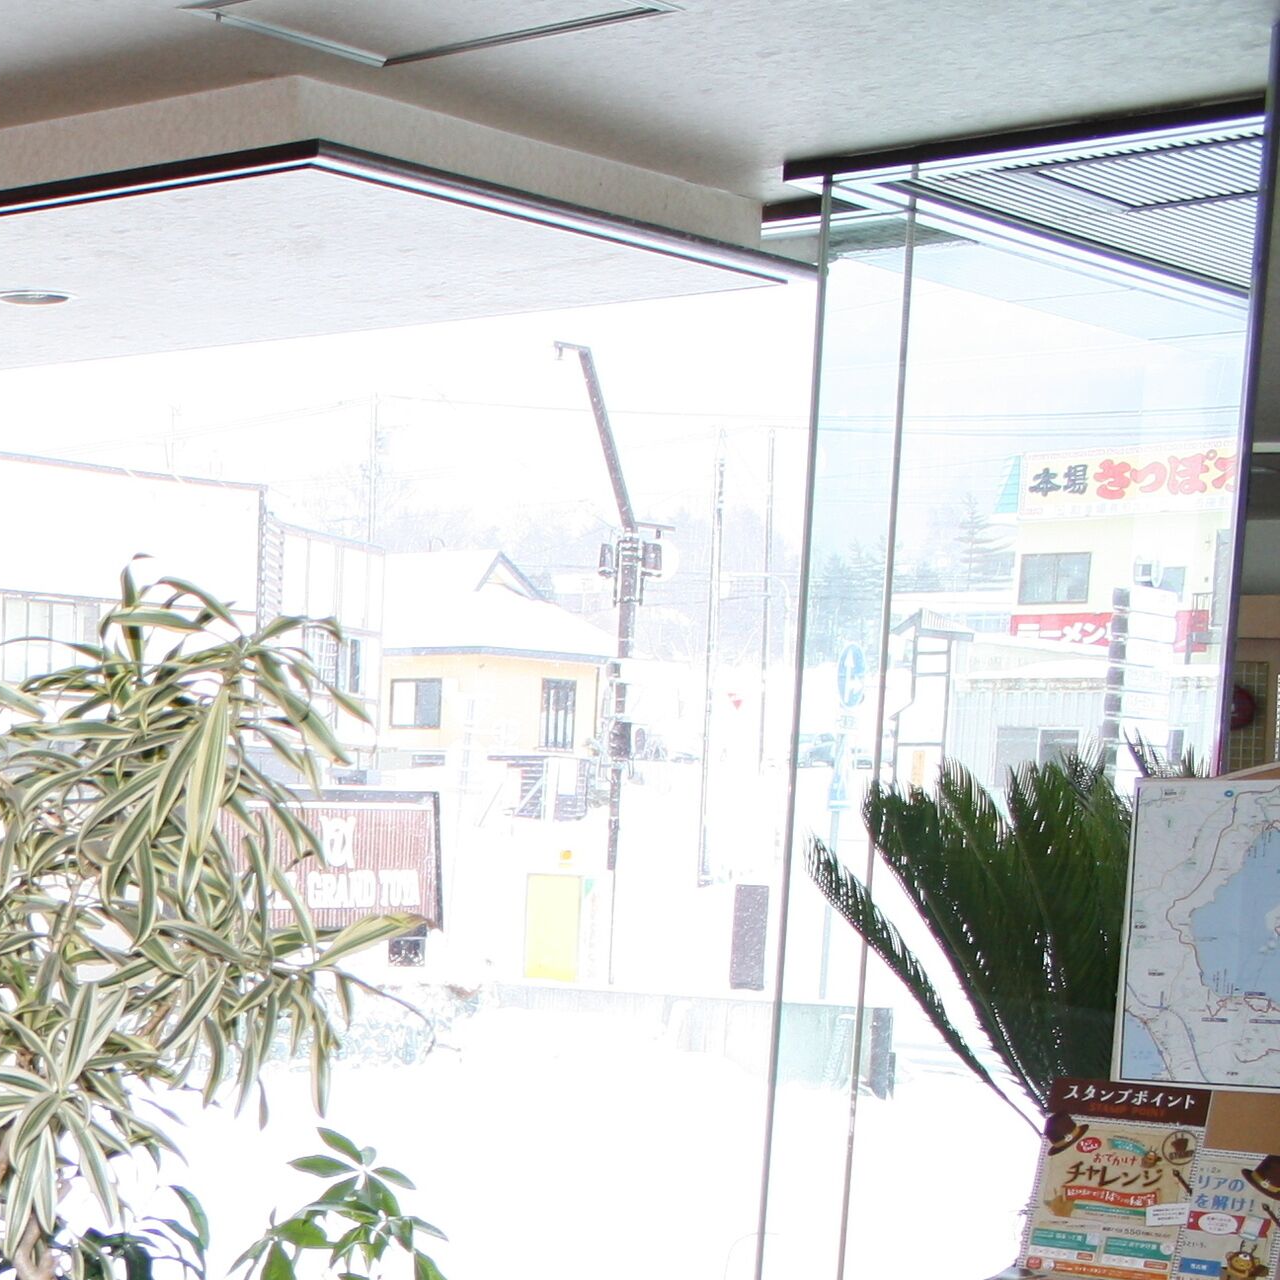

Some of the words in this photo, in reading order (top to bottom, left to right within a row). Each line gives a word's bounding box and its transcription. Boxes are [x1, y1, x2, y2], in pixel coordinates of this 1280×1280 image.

[1028, 464, 1089, 497] 本場
[1016, 621, 1112, 646] ラーメン
[307, 871, 377, 909] GRAND
[1063, 1084, 1196, 1110] スタンプポイント
[1093, 1152, 1138, 1167] おでかけ
[1065, 1161, 1164, 1187] チャレンジ
